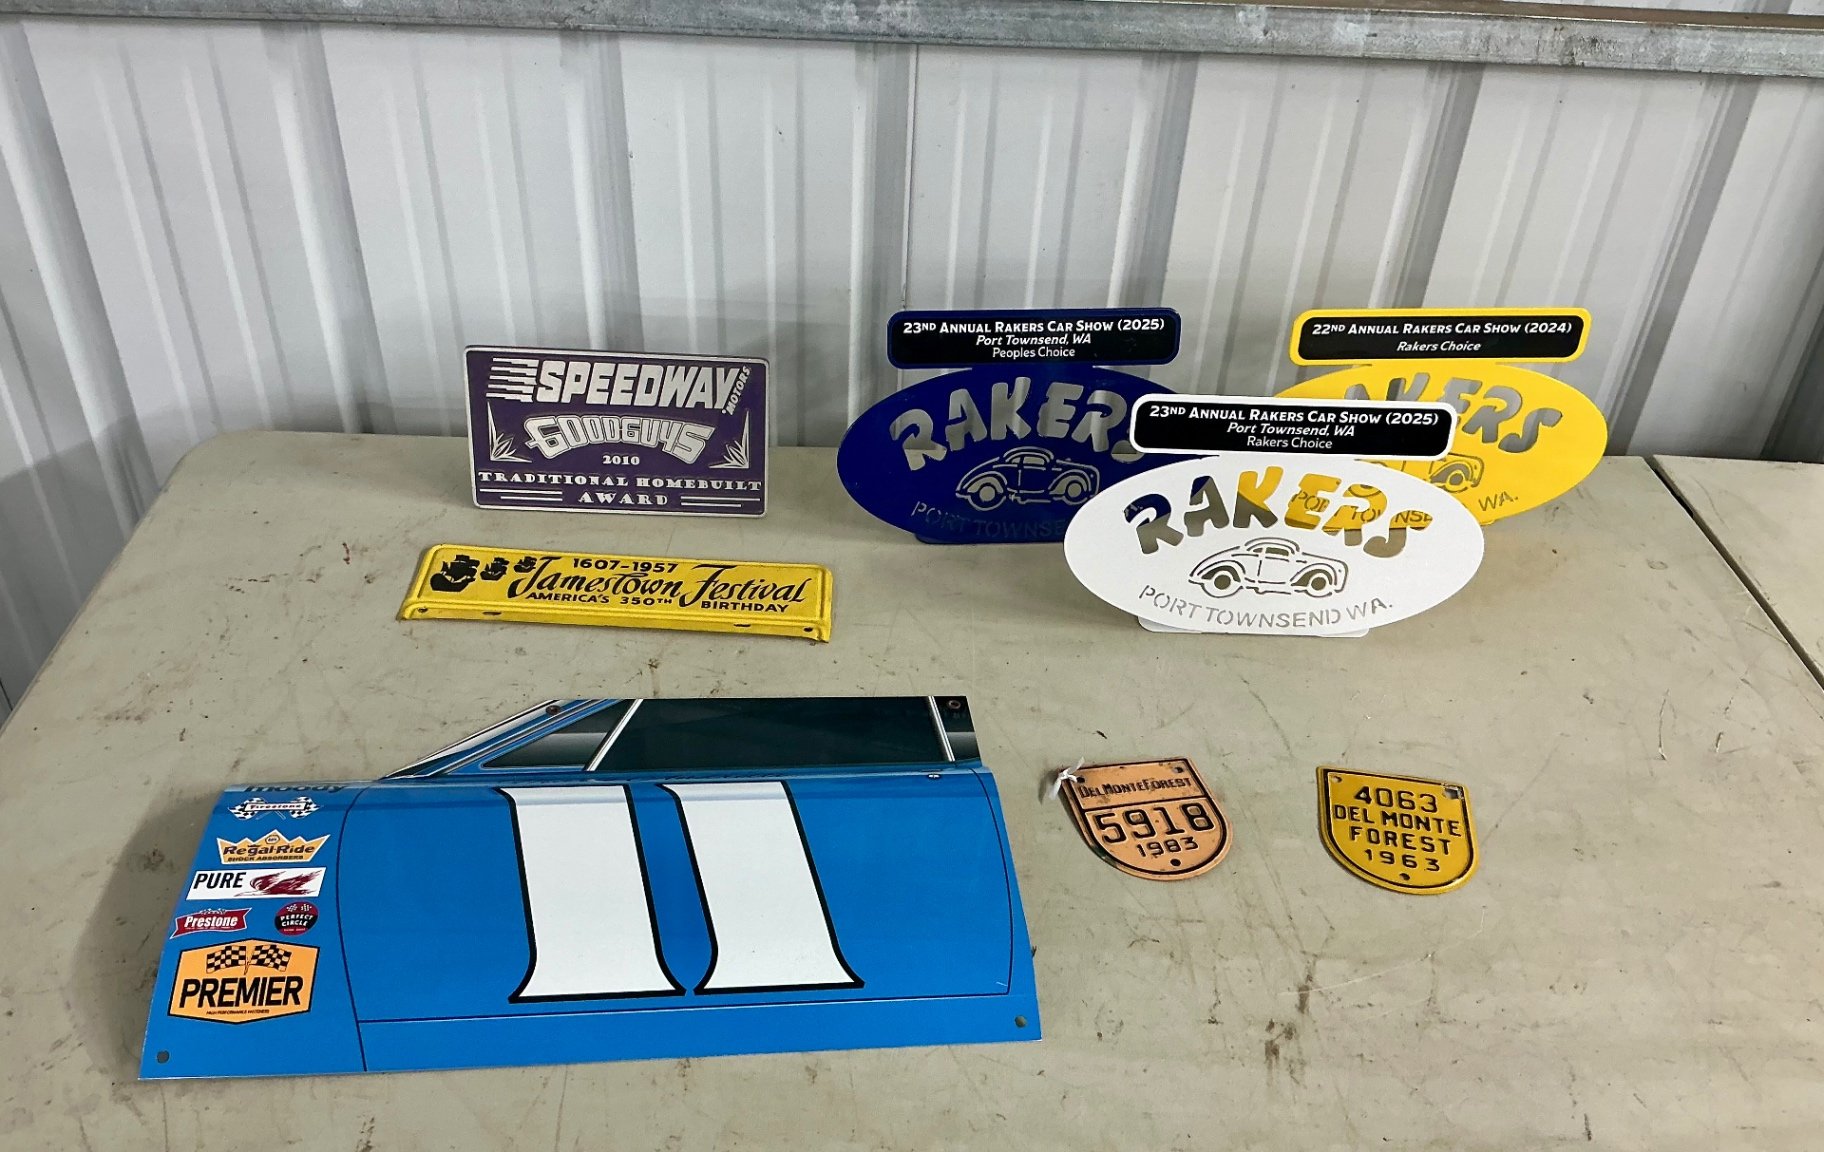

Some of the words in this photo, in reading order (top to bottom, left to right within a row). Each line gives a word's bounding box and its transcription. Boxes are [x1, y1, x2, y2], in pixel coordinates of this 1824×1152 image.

[903, 322, 936, 334] 23ND
[939, 322, 991, 334] ANNUAL
[994, 321, 1044, 333] RAKERS
[1047, 320, 1073, 332] CAR
[1076, 320, 1114, 332] SHOW
[1117, 318, 1165, 331] (2025)
[1312, 323, 1346, 335] 22ND
[1348, 323, 1399, 335] ANNUAL
[1402, 323, 1452, 334] RAKERS
[1455, 322, 1480, 334] CAR
[1483, 322, 1521, 334] SHOW
[1524, 321, 1572, 334] (2024)
[976, 335, 1002, 346] Port
[1006, 334, 1070, 346] Townsend,
[1073, 334, 1092, 345] WA
[1397, 341, 1438, 352] Rakers
[1440, 340, 1481, 351] Choice
[992, 347, 1036, 360] Peoples
[1038, 346, 1076, 357] Choice
[536, 360, 740, 410] SPEEDWAY
[724, 366, 751, 415] MOTORS
[1149, 405, 1187, 418] 23ND
[1189, 407, 1246, 420] ANNUAL
[1249, 409, 1303, 422] RAKERS
[1307, 410, 1336, 423] CAR
[1339, 411, 1382, 424] SHOW
[1385, 412, 1440, 426] (2025)
[524, 415, 716, 464] GOODGUYS
[1226, 422, 1256, 434] Port
[1260, 423, 1330, 437] Townsend,
[1333, 425, 1355, 437] WA
[1247, 436, 1289, 448] Rakers
[1291, 437, 1333, 449] Choice
[602, 455, 640, 466] 2010
[478, 472, 628, 487] TRADITIONAL
[636, 477, 762, 491] HOMEBUILT
[578, 492, 669, 506] AWARD
[1123, 466, 1433, 558] RAKERS
[573, 557, 679, 573] 1607-1957
[507, 556, 685, 599] Jamestown
[679, 564, 811, 608] Festival
[526, 591, 610, 604] AMERICA'S
[620, 596, 672, 606] 350TH
[701, 600, 790, 614] BIRTHDAY
[1139, 584, 1202, 622] PORT
[1207, 607, 1342, 629] TOWNSEND
[1346, 597, 1393, 621] WA.
[1354, 786, 1438, 813] 4063
[1095, 802, 1214, 843] 5918
[1334, 804, 1374, 824] DEL
[1381, 811, 1462, 837] MONTE
[1136, 836, 1199, 857] 1983
[1350, 826, 1451, 855] FOREST
[1364, 849, 1440, 872] 1963
[193, 872, 246, 889] PURE
[184, 916, 238, 928] Prestone
[179, 975, 304, 1008] PREMIER
